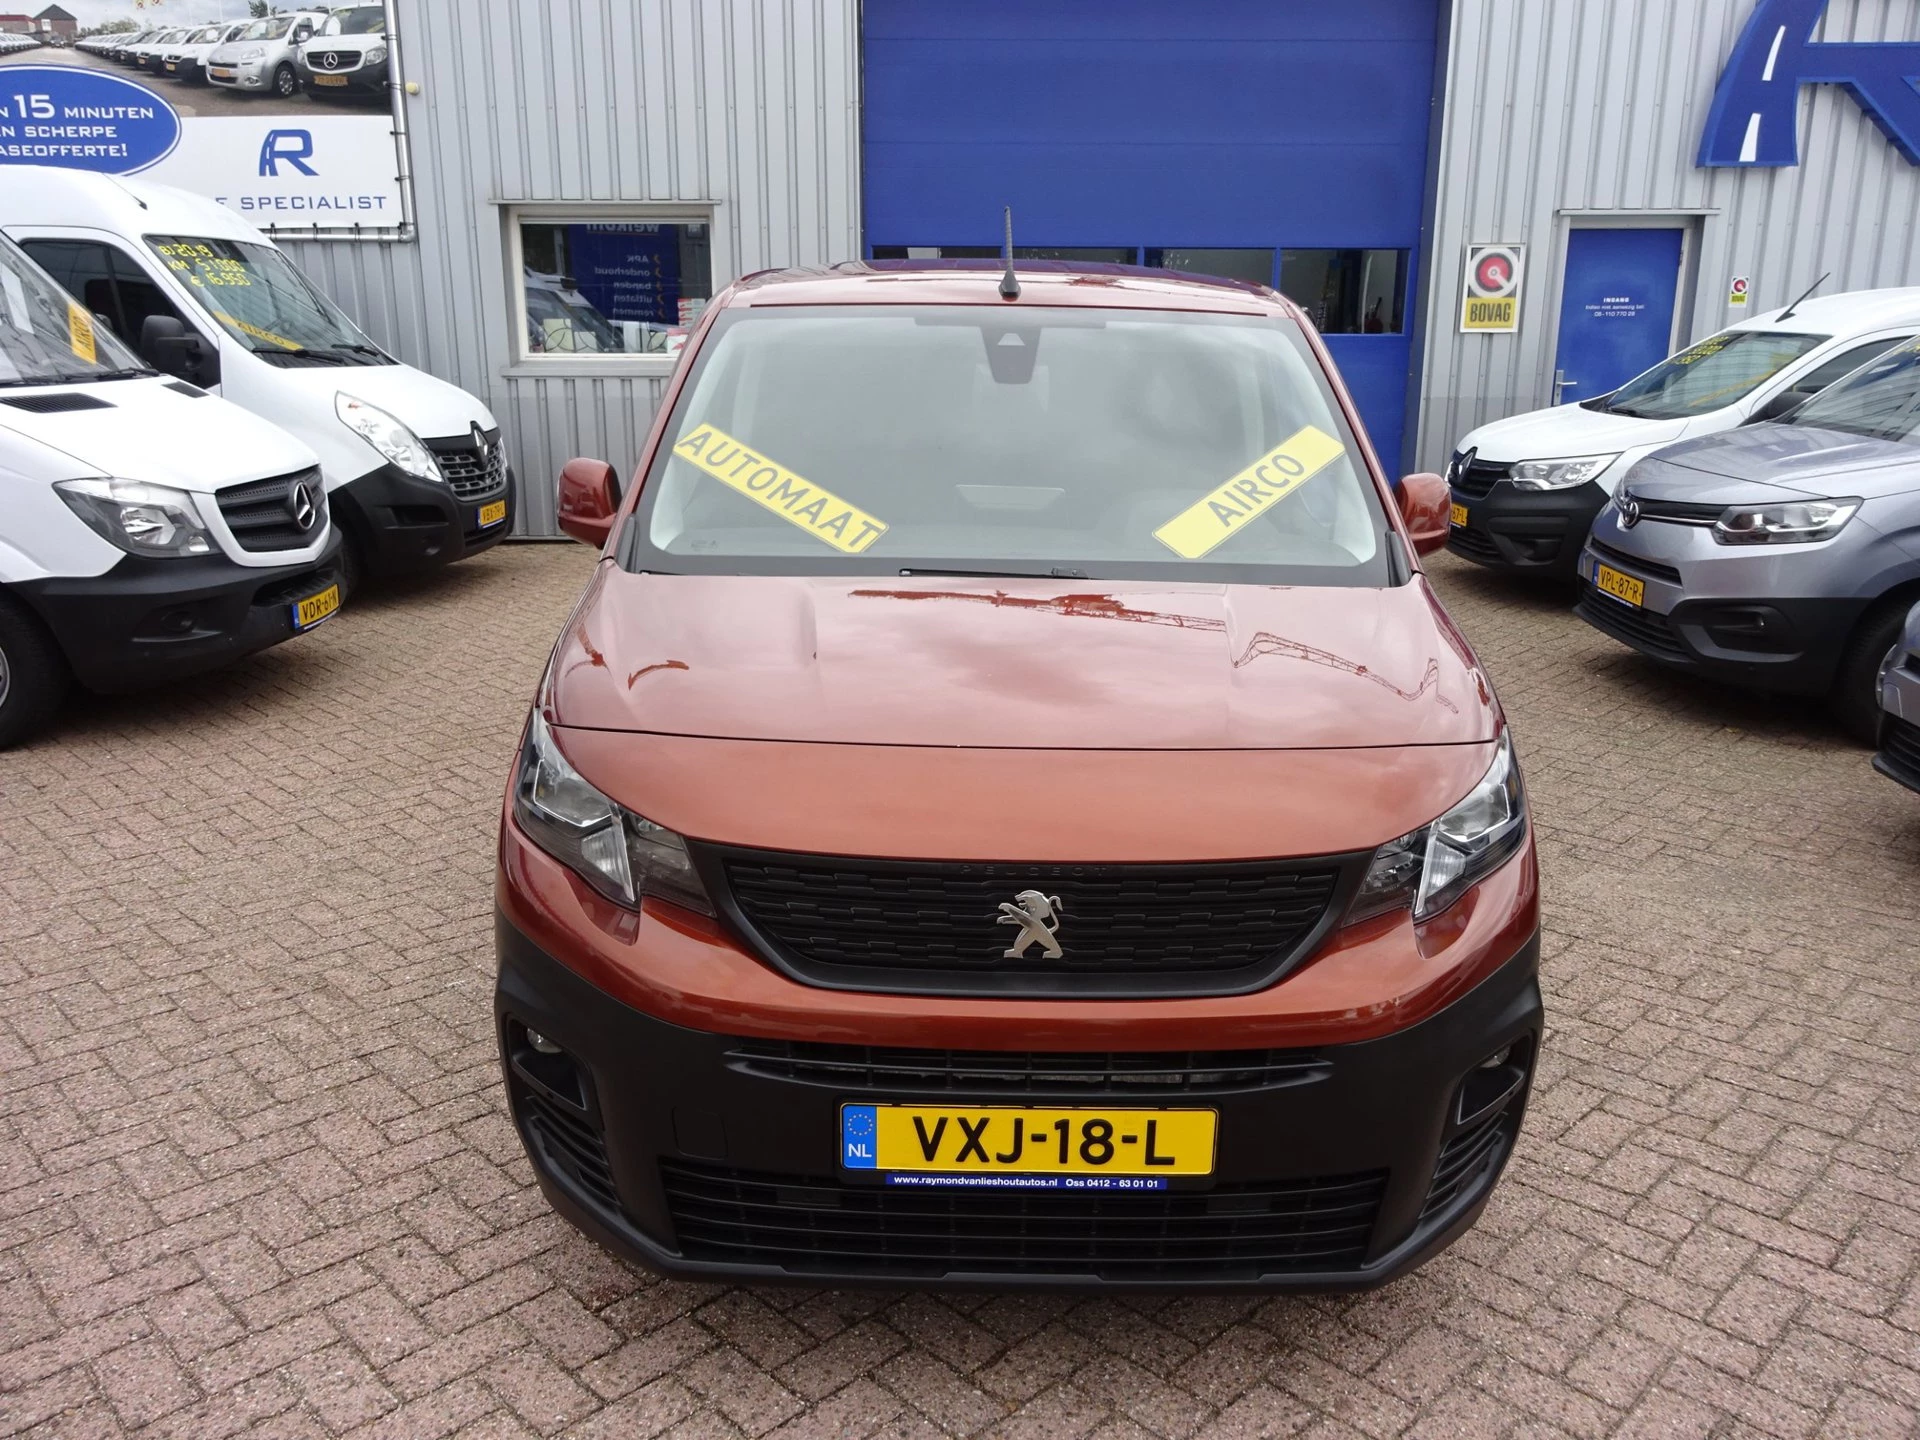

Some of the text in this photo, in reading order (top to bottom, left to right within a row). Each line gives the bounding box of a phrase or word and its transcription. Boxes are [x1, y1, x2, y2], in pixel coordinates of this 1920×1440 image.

[0, 94, 154, 119] N 15 MINUTEN
[0, 126, 117, 138] N SCHERPE
[0, 143, 128, 157] ASEOFFERTE!
[241, 196, 387, 210] SPECIALIST
[1471, 303, 1511, 322] BOVAG
[679, 431, 884, 548] AUTOMAAT
[1207, 454, 1305, 528] AIRCO
[848, 1116, 1176, 1166] NL VXJ-18-L
[894, 1176, 1058, 1187] www.raymondvanlieshoutautos.nl
[1065, 1178, 1085, 1187] Oss
[1087, 1178, 1110, 1188] 0412
[1119, 1179, 1131, 1188] 63
[1133, 1179, 1144, 1188] 01
[1147, 1179, 1158, 1188] 01
